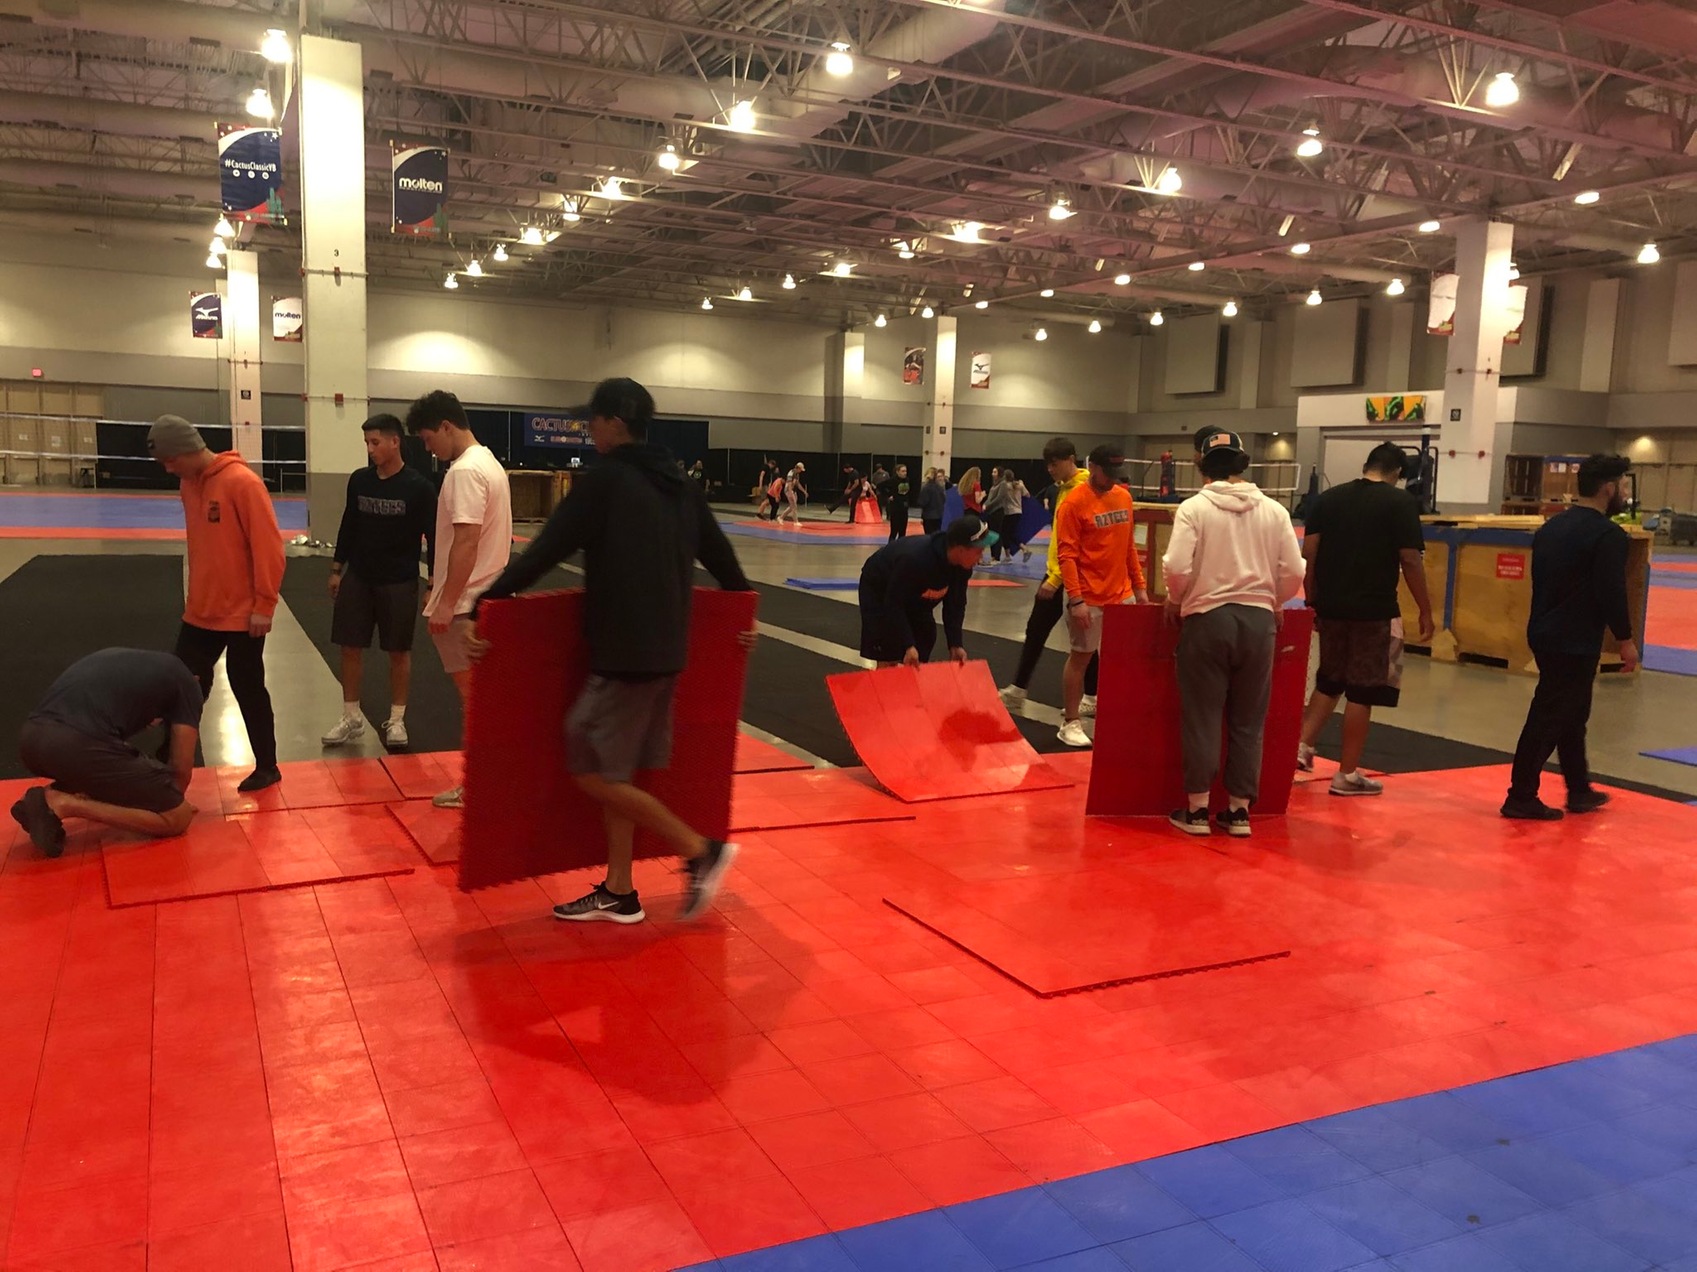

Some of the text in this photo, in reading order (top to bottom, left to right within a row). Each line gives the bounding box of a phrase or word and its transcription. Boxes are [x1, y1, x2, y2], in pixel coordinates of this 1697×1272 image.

[224, 159, 277, 173] #CactusClassicVB
[399, 177, 443, 192] molten
[333, 248, 340, 257] 3
